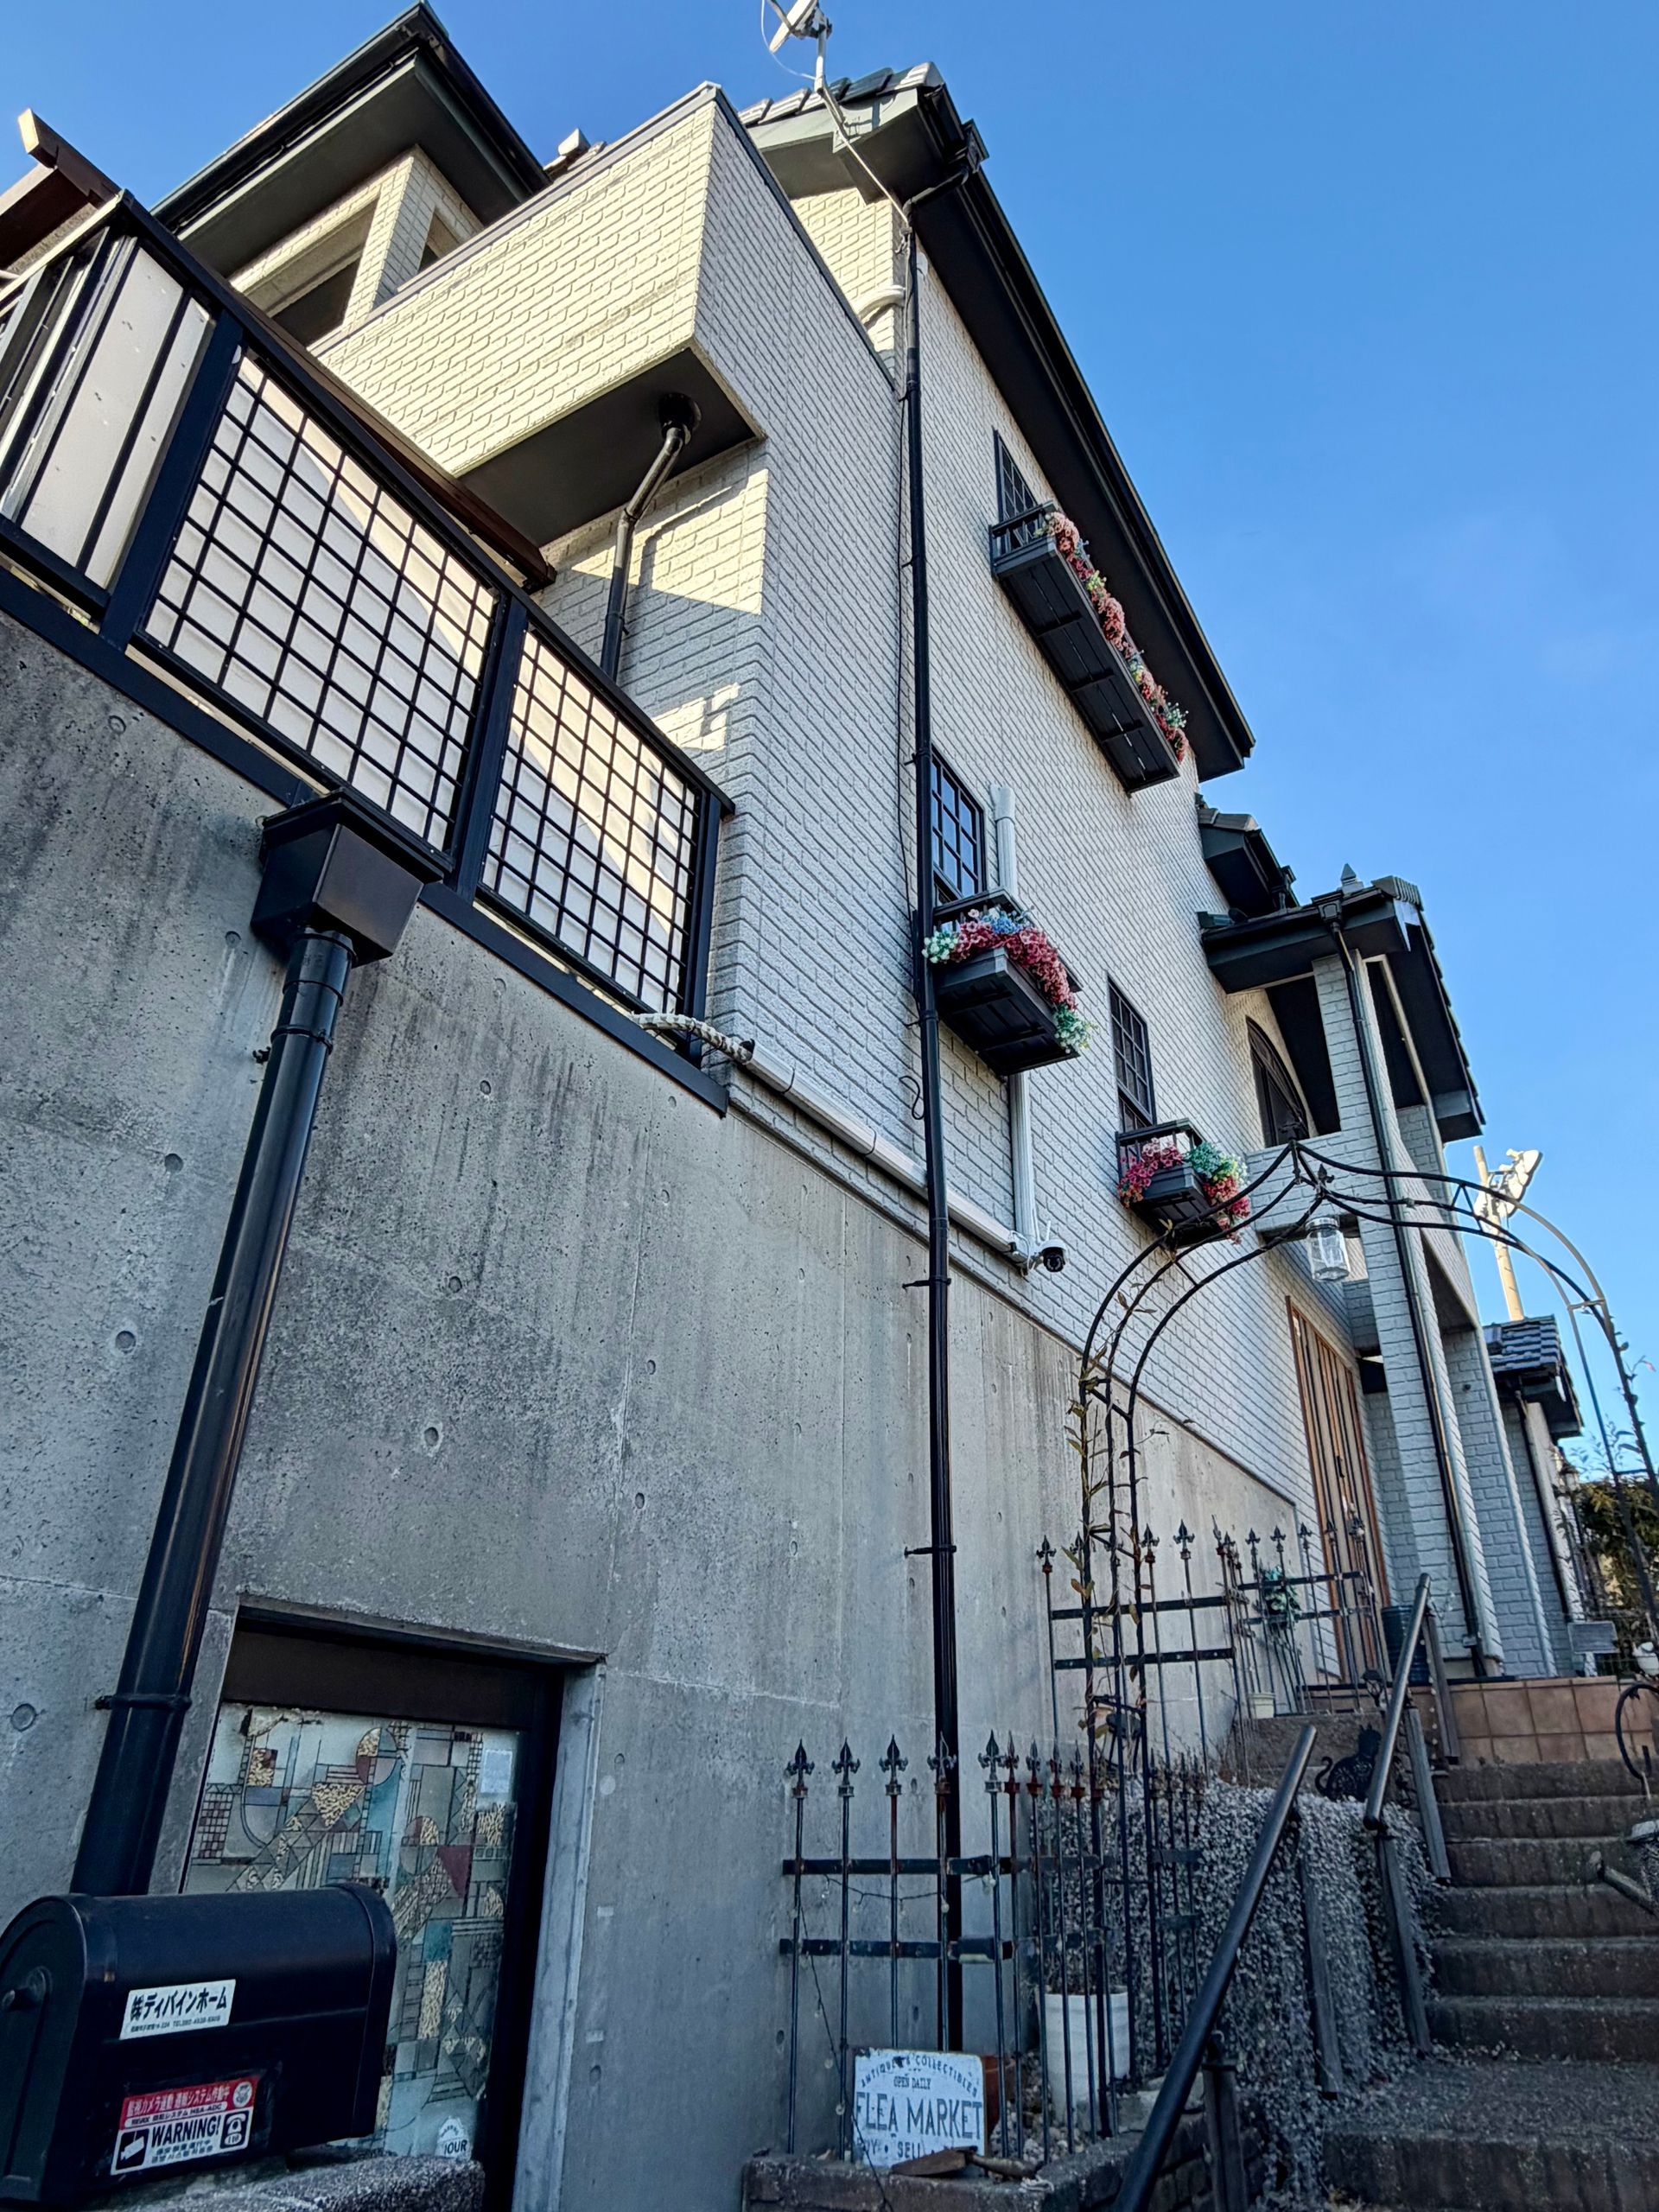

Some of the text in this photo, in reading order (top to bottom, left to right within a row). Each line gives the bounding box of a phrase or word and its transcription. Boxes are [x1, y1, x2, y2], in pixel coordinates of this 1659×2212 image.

[861, 2055, 904, 2088] ANTIQUE
[915, 2054, 978, 2098] COLLECTIBLES
[893, 2075, 931, 2090] OPEN DAILY
[151, 2115, 221, 2148] WARNING!
[855, 2091, 982, 2140] FLEA MARKET
